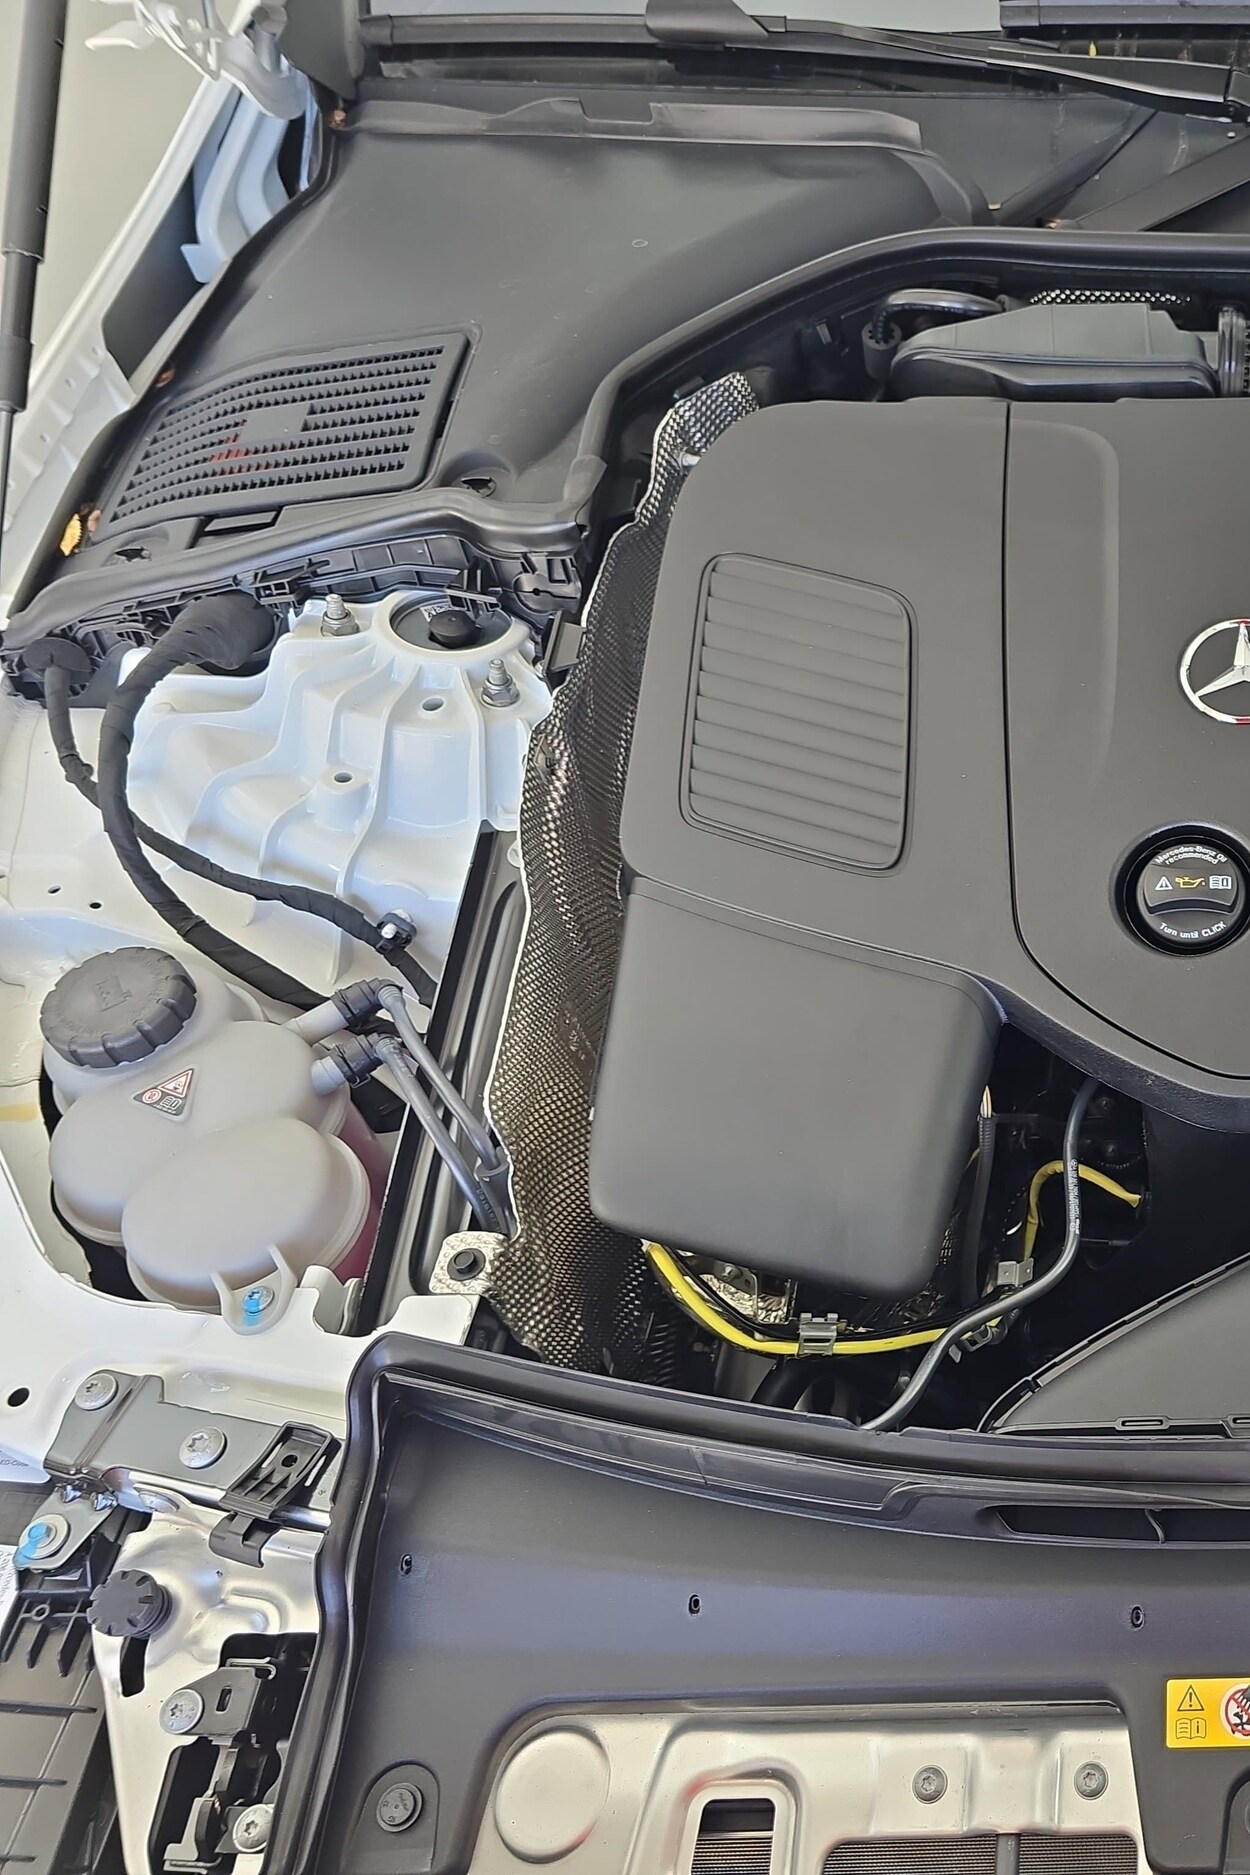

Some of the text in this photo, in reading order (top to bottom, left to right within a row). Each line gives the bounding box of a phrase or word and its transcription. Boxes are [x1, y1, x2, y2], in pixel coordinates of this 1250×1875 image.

[1154, 845, 1217, 864] Mercedes-Benz
[1165, 852, 1220, 866] recommended
[1159, 921, 1227, 939] Turn until CLICK
